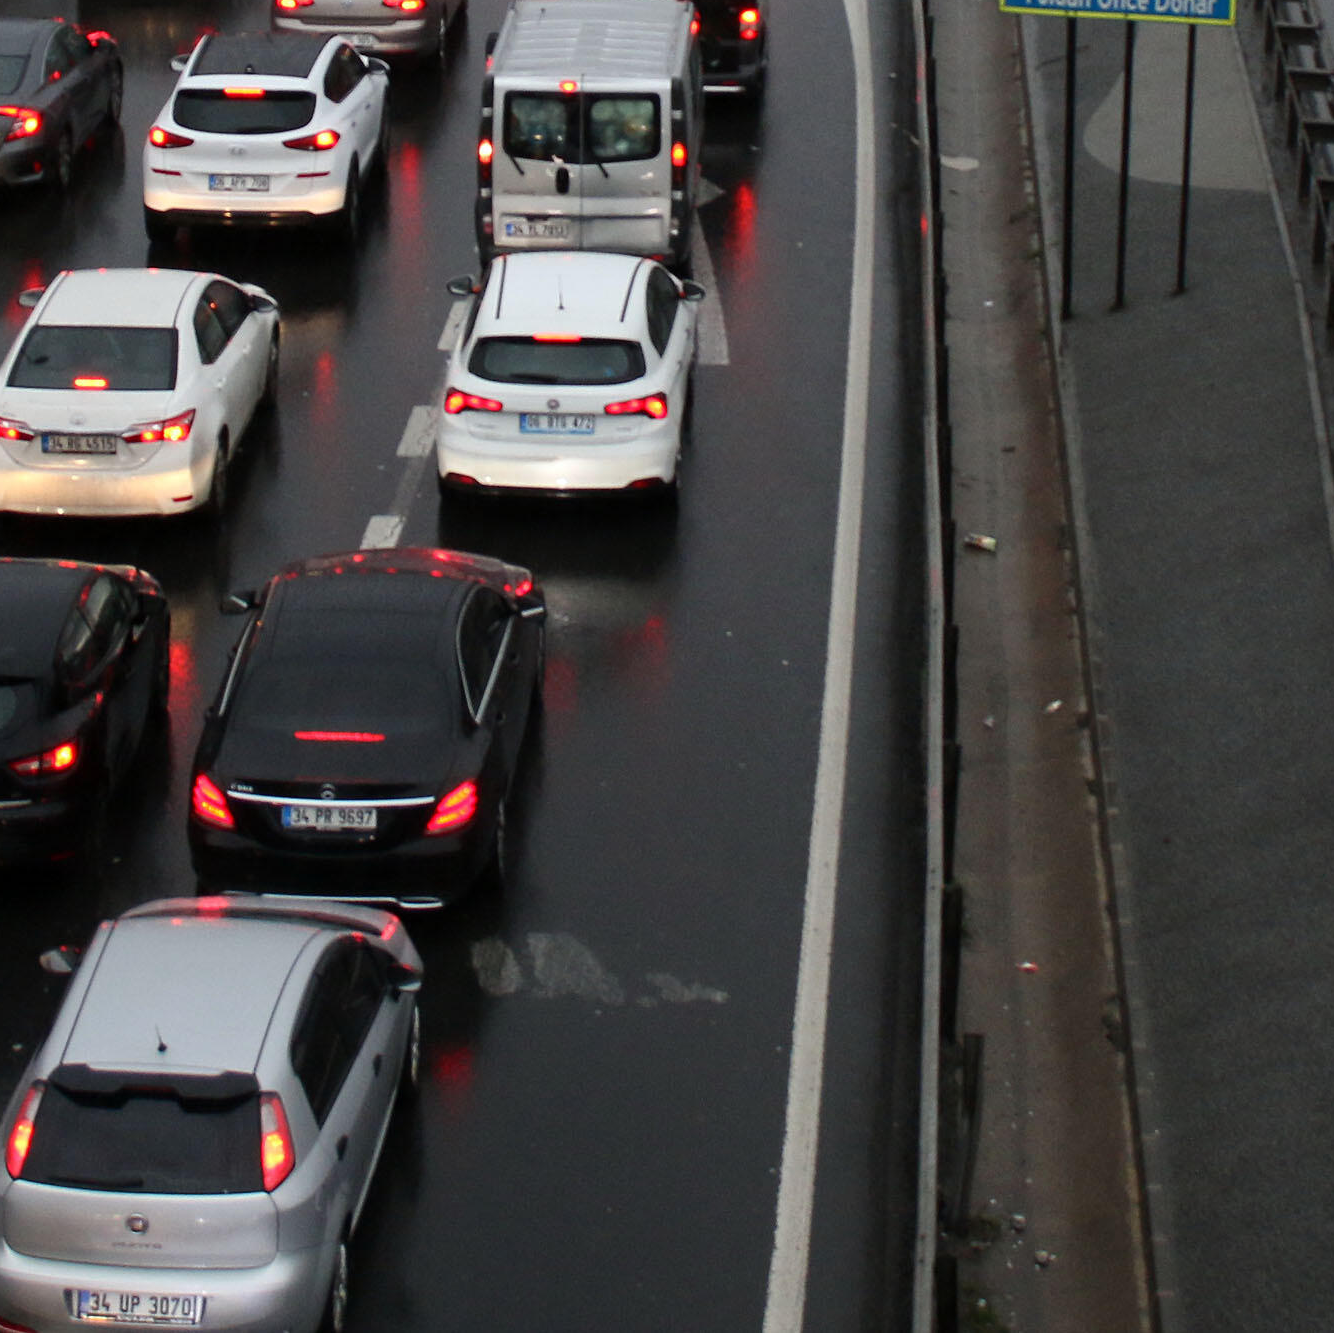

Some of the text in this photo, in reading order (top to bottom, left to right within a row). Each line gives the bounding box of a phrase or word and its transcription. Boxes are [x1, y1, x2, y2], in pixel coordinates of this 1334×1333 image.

[292, 808, 373, 825] 34 PR 9697
[90, 1292, 192, 1316] 34 UP 3070
